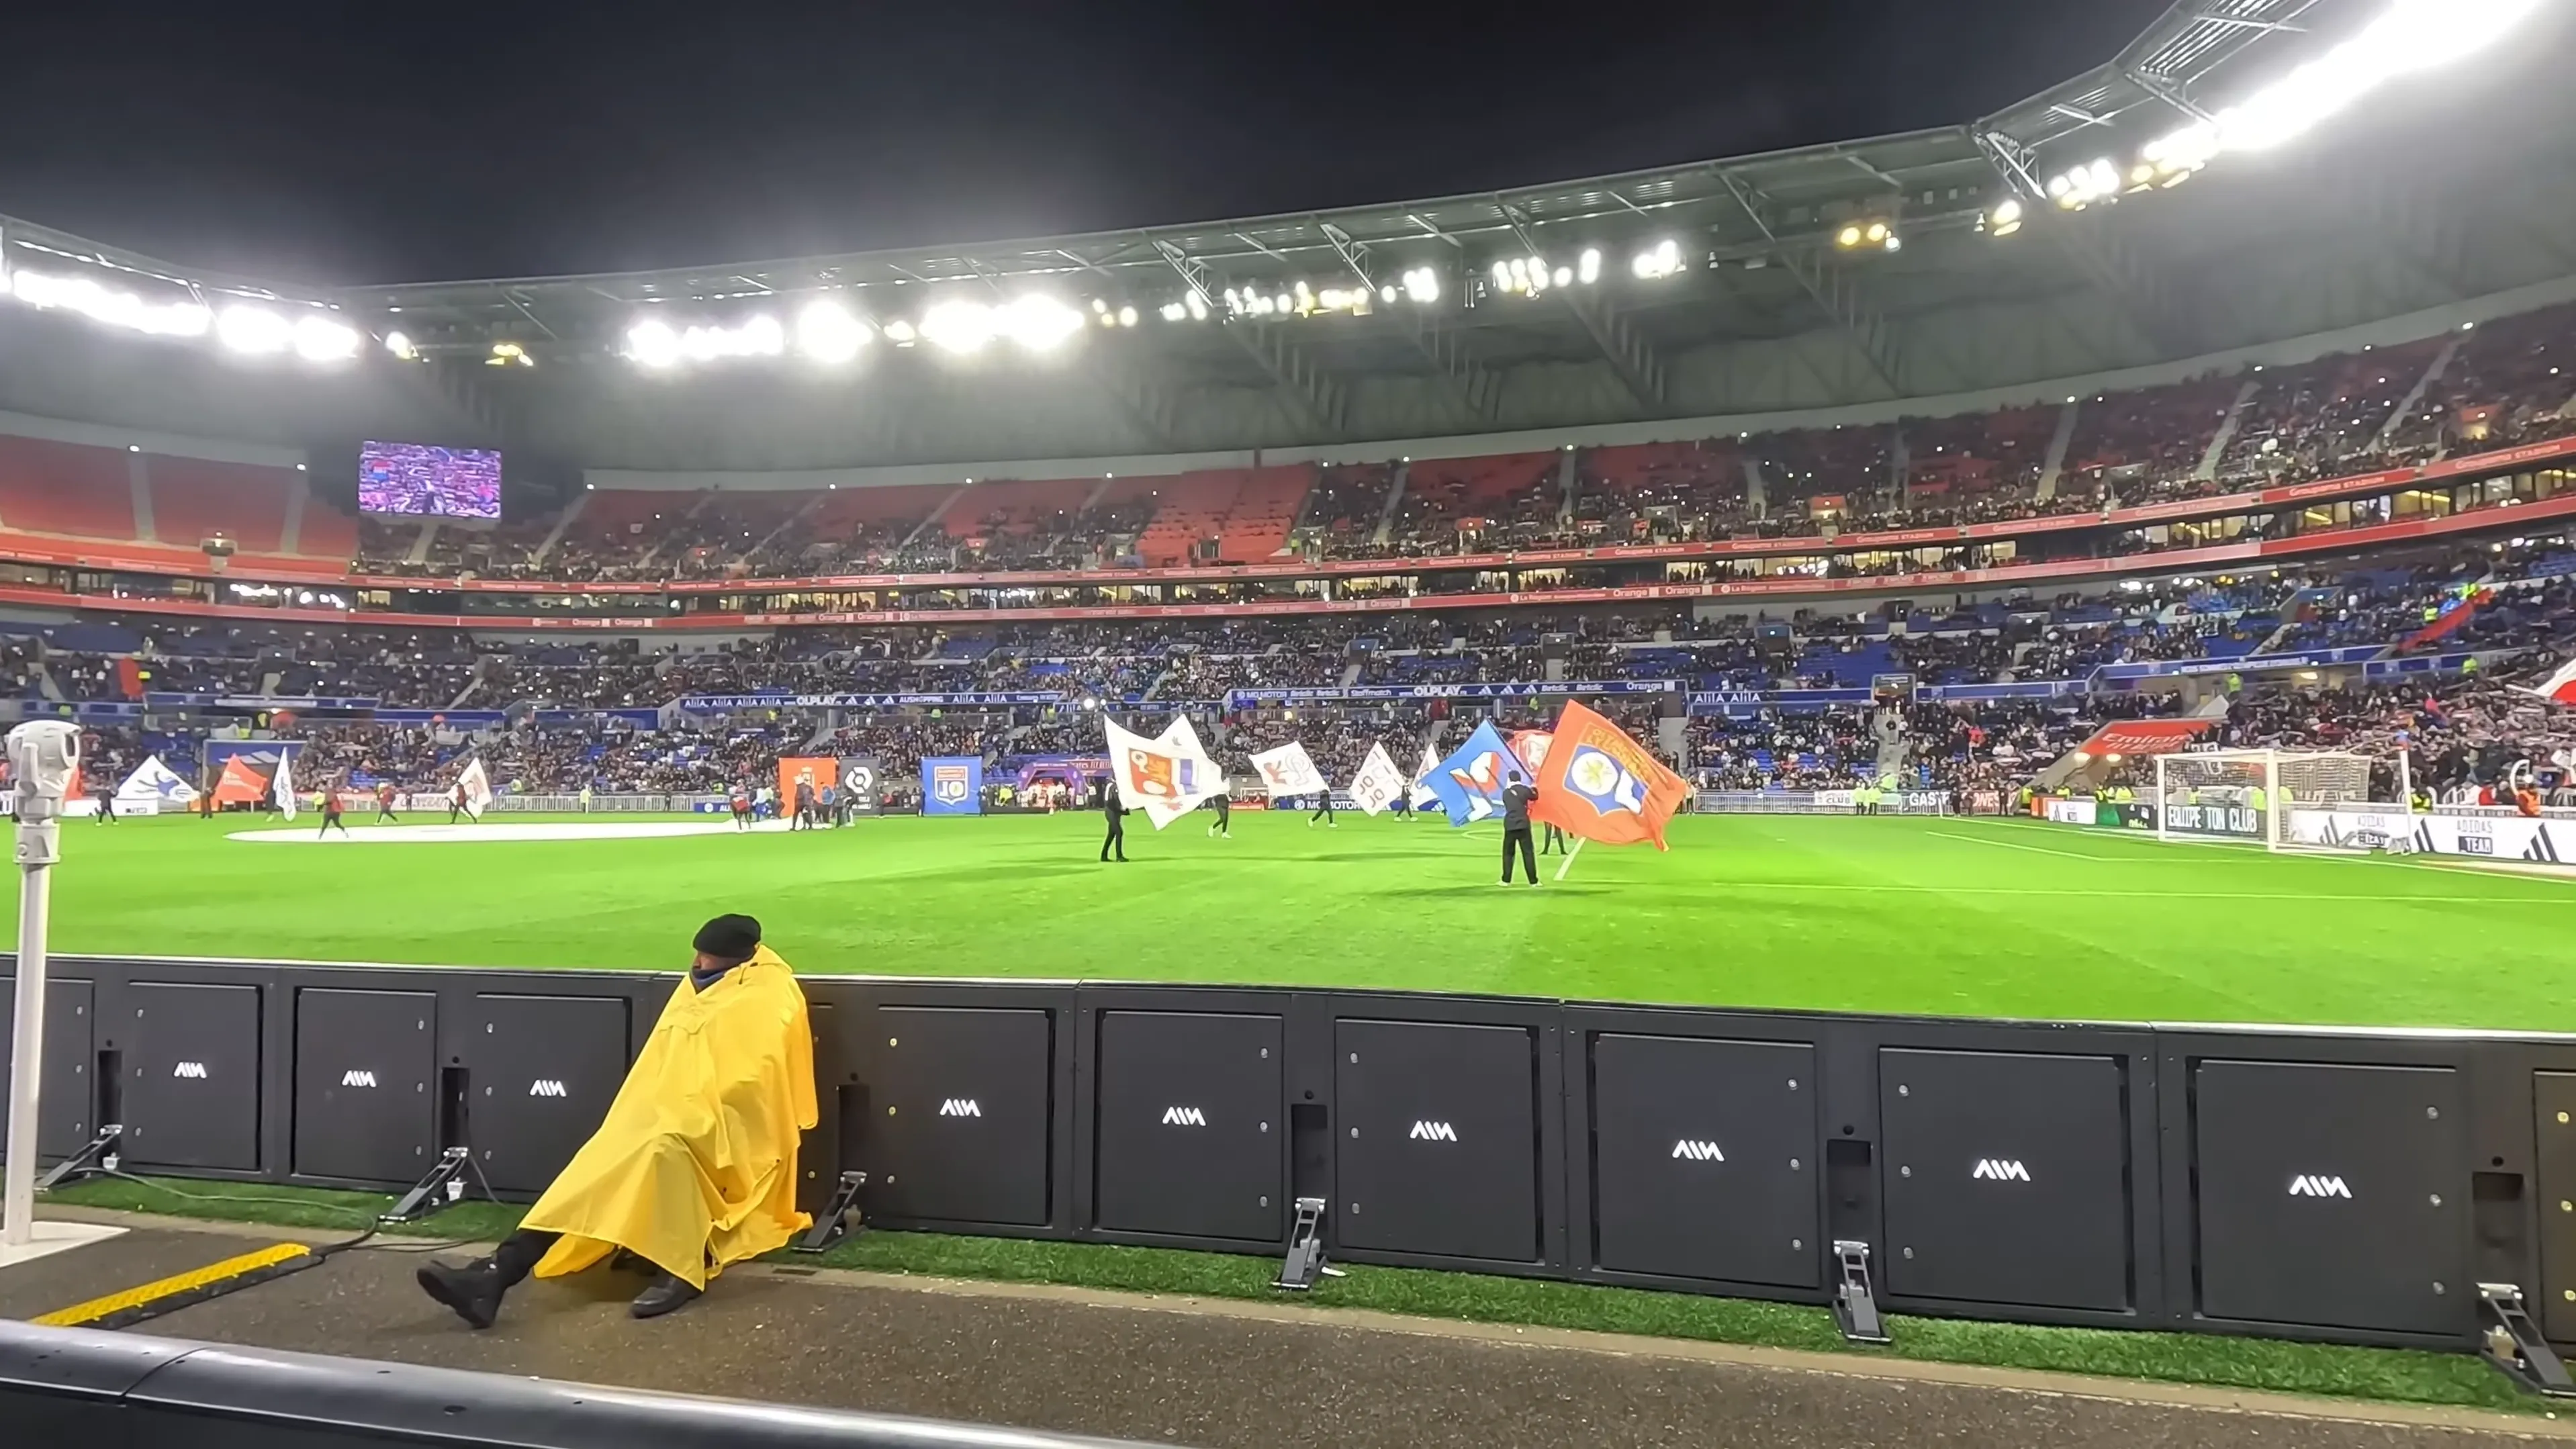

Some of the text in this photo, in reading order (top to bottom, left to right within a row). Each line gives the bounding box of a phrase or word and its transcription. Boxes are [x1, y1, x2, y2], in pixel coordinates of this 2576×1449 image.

[2167, 805, 2202, 829] EQUIPE
[2205, 806, 2225, 830] TON
[2229, 808, 2257, 833] CLUB
[2457, 819, 2492, 833] ADIDAS
